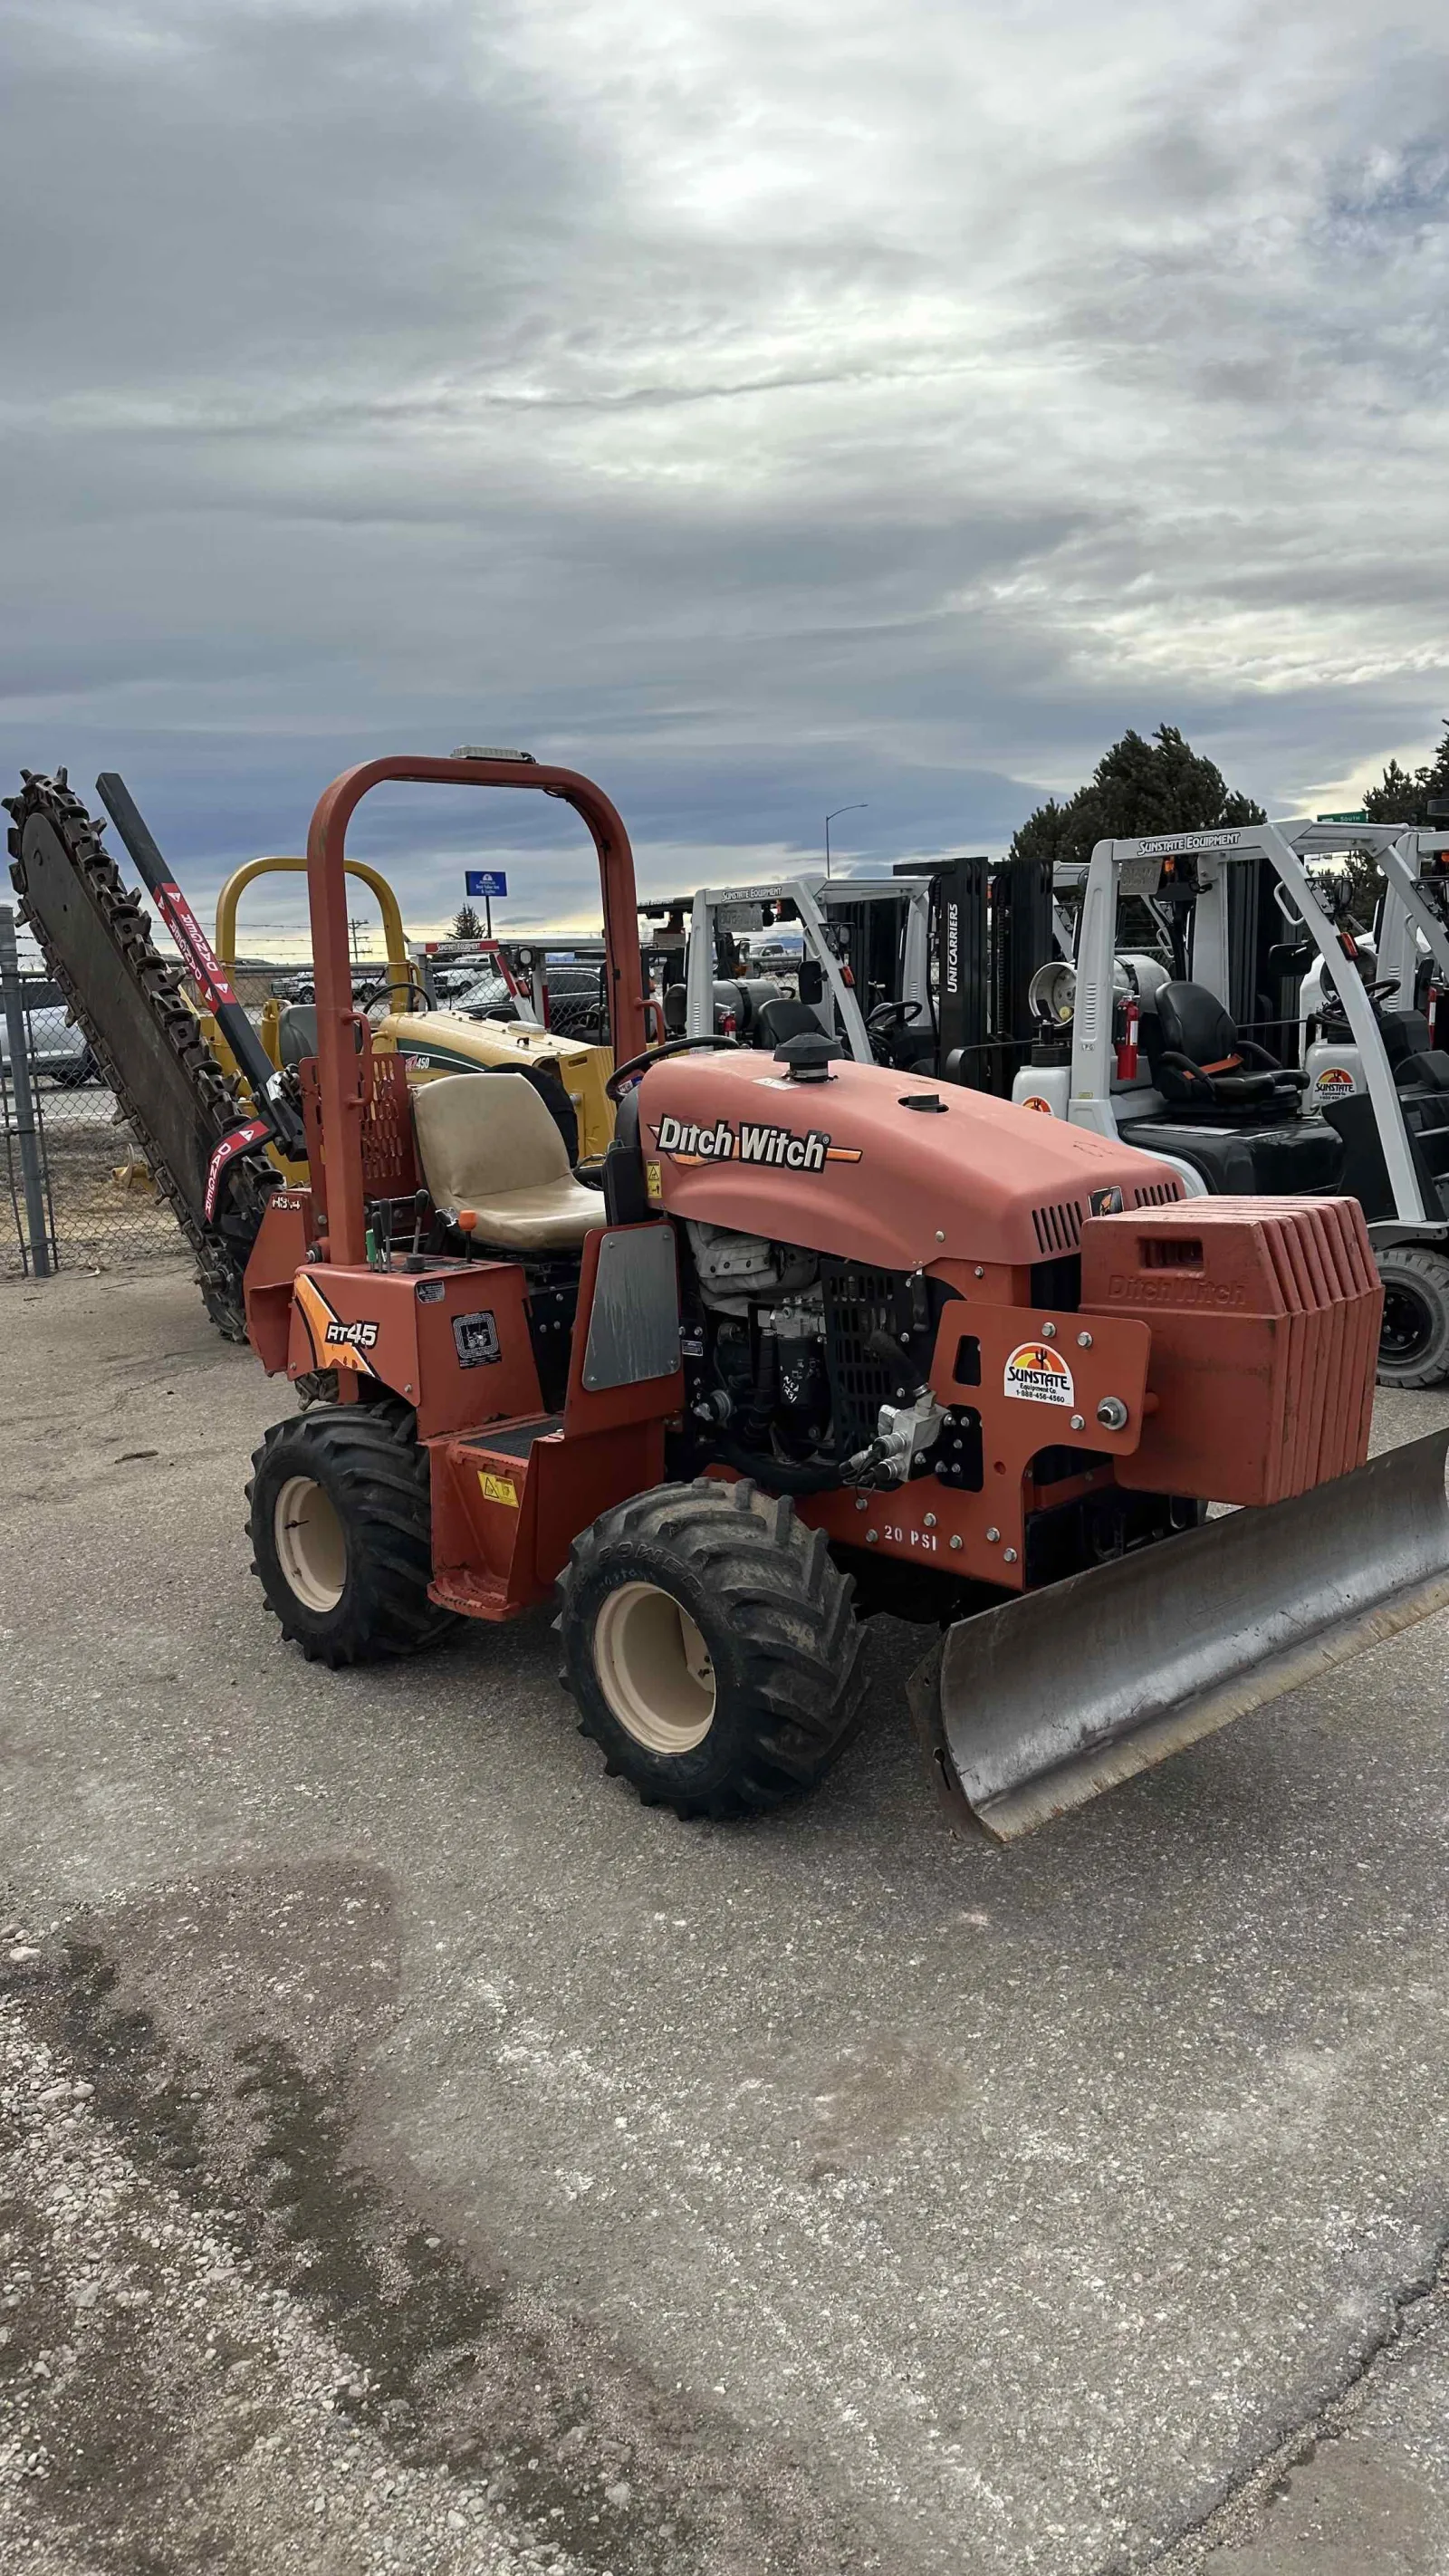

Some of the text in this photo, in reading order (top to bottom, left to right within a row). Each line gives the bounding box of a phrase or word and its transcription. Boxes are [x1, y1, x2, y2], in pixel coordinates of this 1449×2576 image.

[1137, 832, 1241, 856] SUNSTATE EQUIPMENT
[722, 887, 782, 902] SUNSTATE EQUIPMENT
[169, 919, 202, 981] DANGER
[181, 914, 219, 972] DANGER
[1315, 1082, 1355, 1092] SUNSTATE
[659, 1117, 733, 1158] Ditch
[205, 1142, 232, 1215] DANGER
[1108, 1274, 1171, 1302] Ditch
[327, 1322, 379, 1347] RT45
[1007, 1366, 1070, 1391] SUNSTATE
[1020, 1382, 1049, 1394] Equipment
[884, 1524, 936, 1551] 20 PSI
